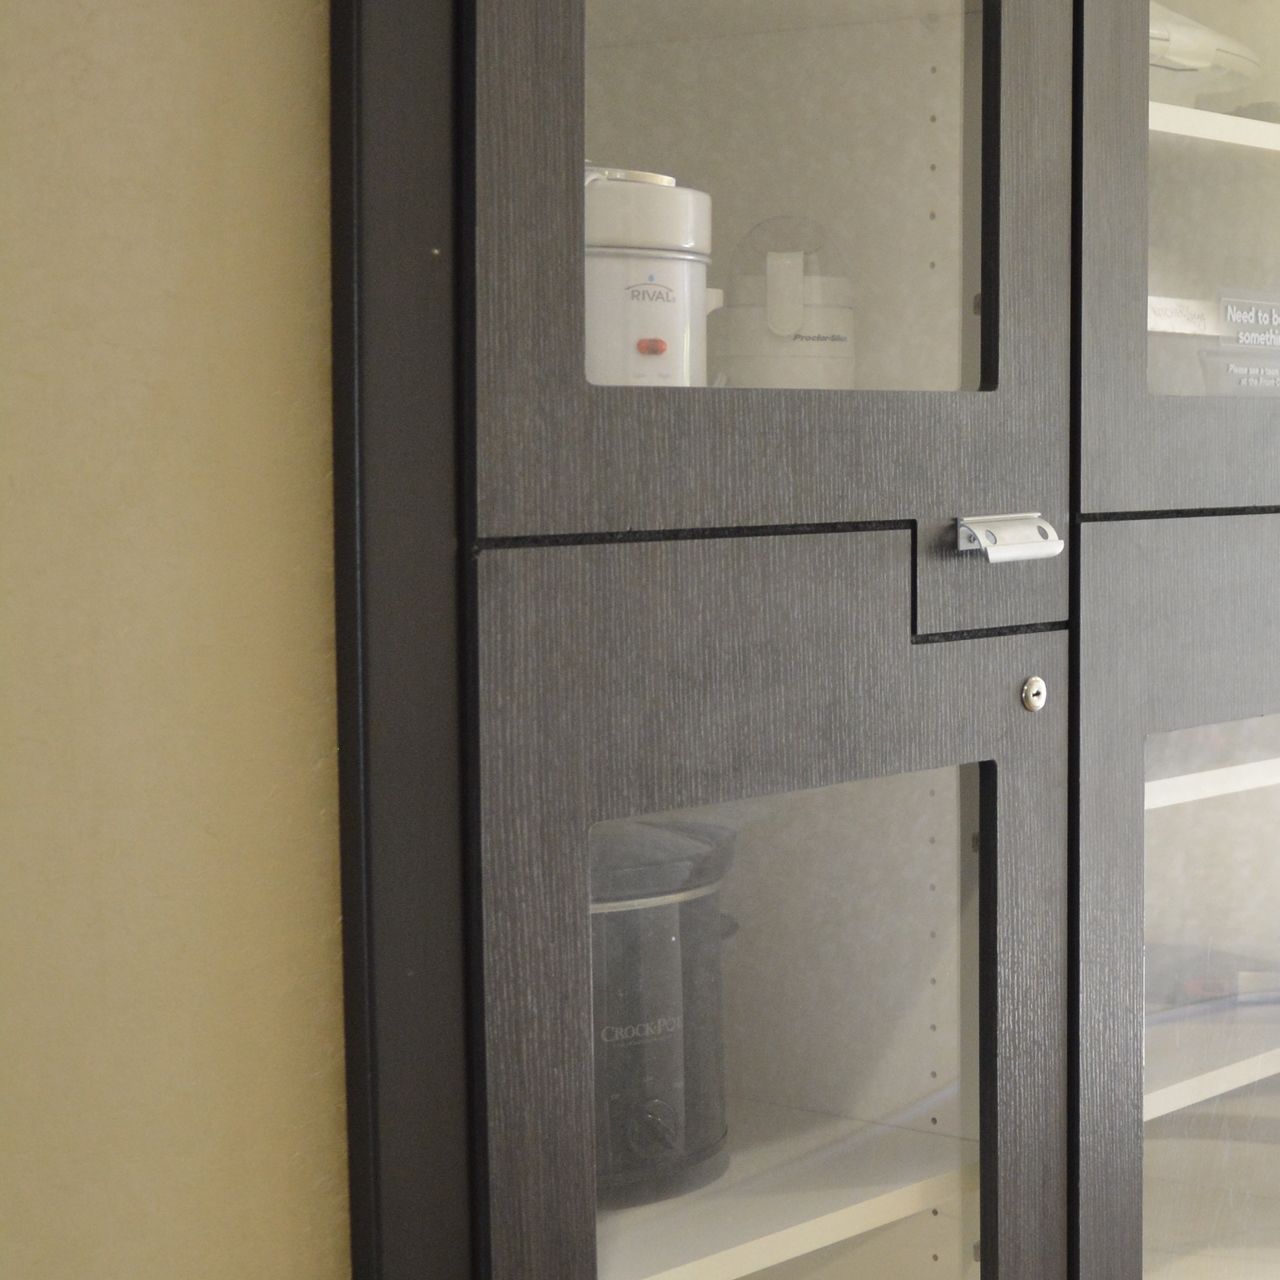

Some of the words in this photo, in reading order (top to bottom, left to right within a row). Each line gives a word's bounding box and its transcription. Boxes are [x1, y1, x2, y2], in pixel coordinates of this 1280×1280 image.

[630, 289, 672, 303] RIVAL
[1227, 304, 1255, 324] Need
[1258, 310, 1269, 325] to
